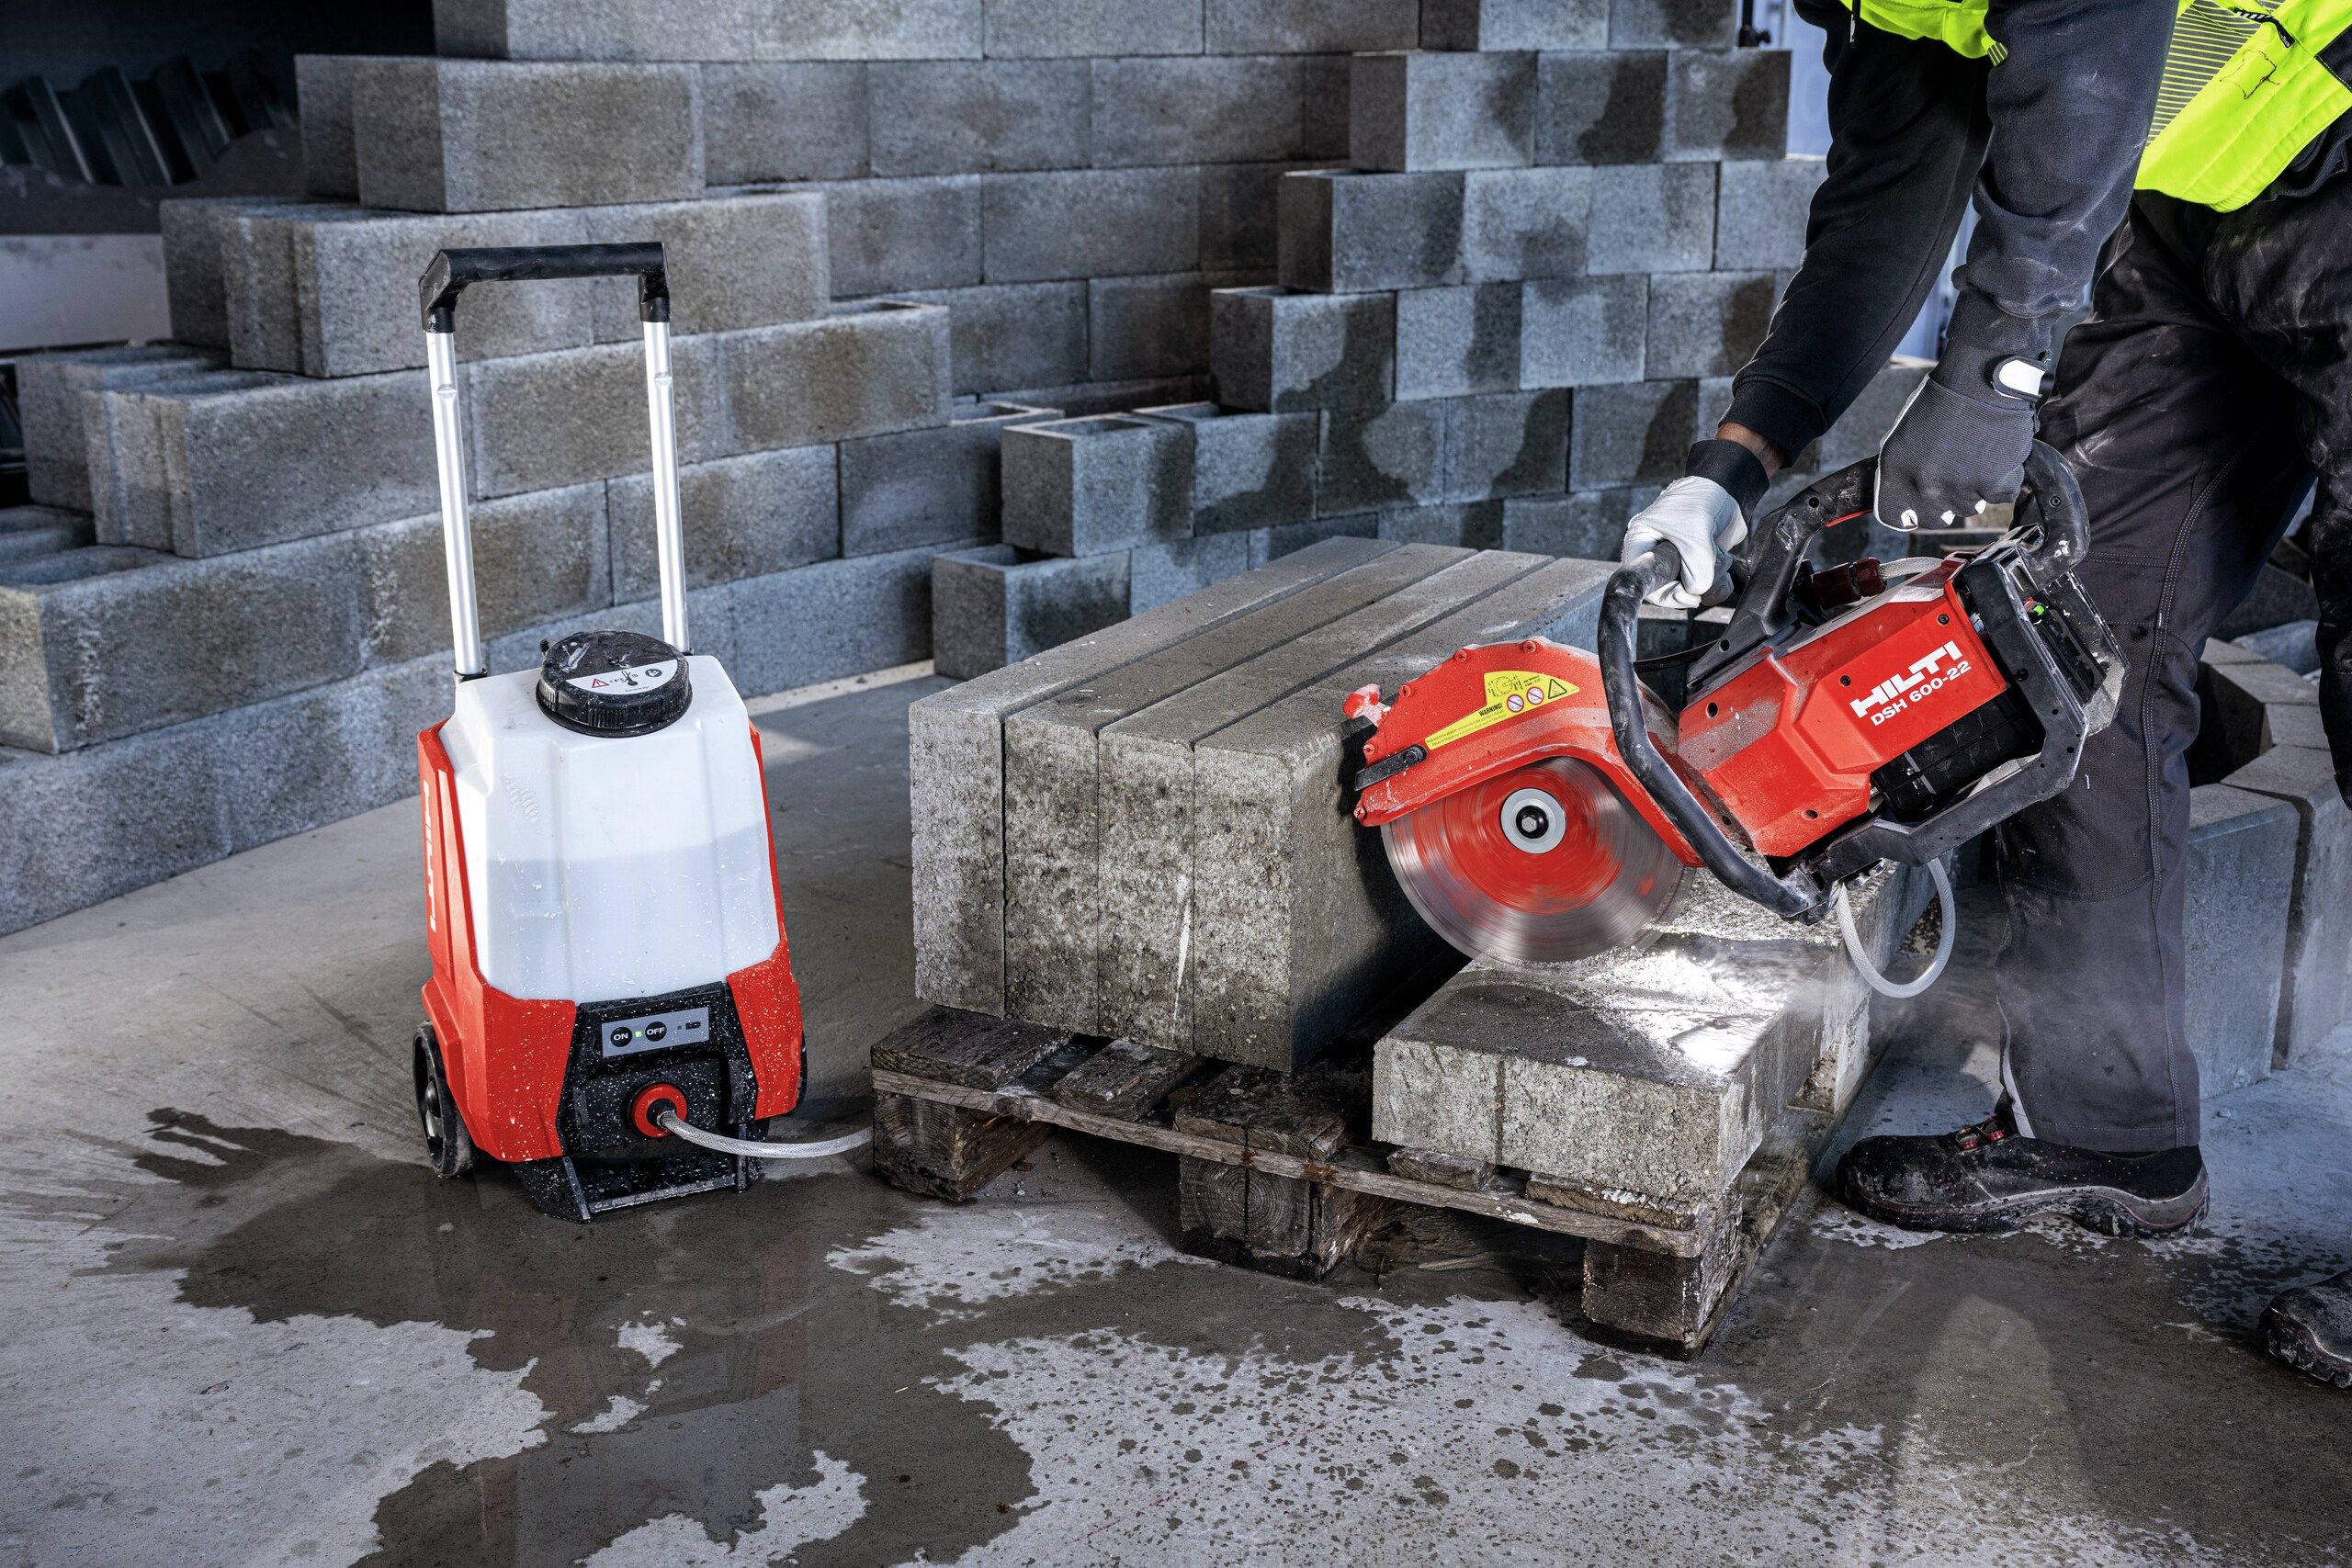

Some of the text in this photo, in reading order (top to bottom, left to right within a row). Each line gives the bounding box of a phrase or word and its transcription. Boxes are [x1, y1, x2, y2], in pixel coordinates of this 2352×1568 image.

[1478, 703, 1503, 716] WARNING!
[1849, 640, 1963, 718] HILTI
[1870, 660, 1972, 727] DSH 600-22
[423, 779, 437, 933] HILTI
[613, 1032, 628, 1041] ON
